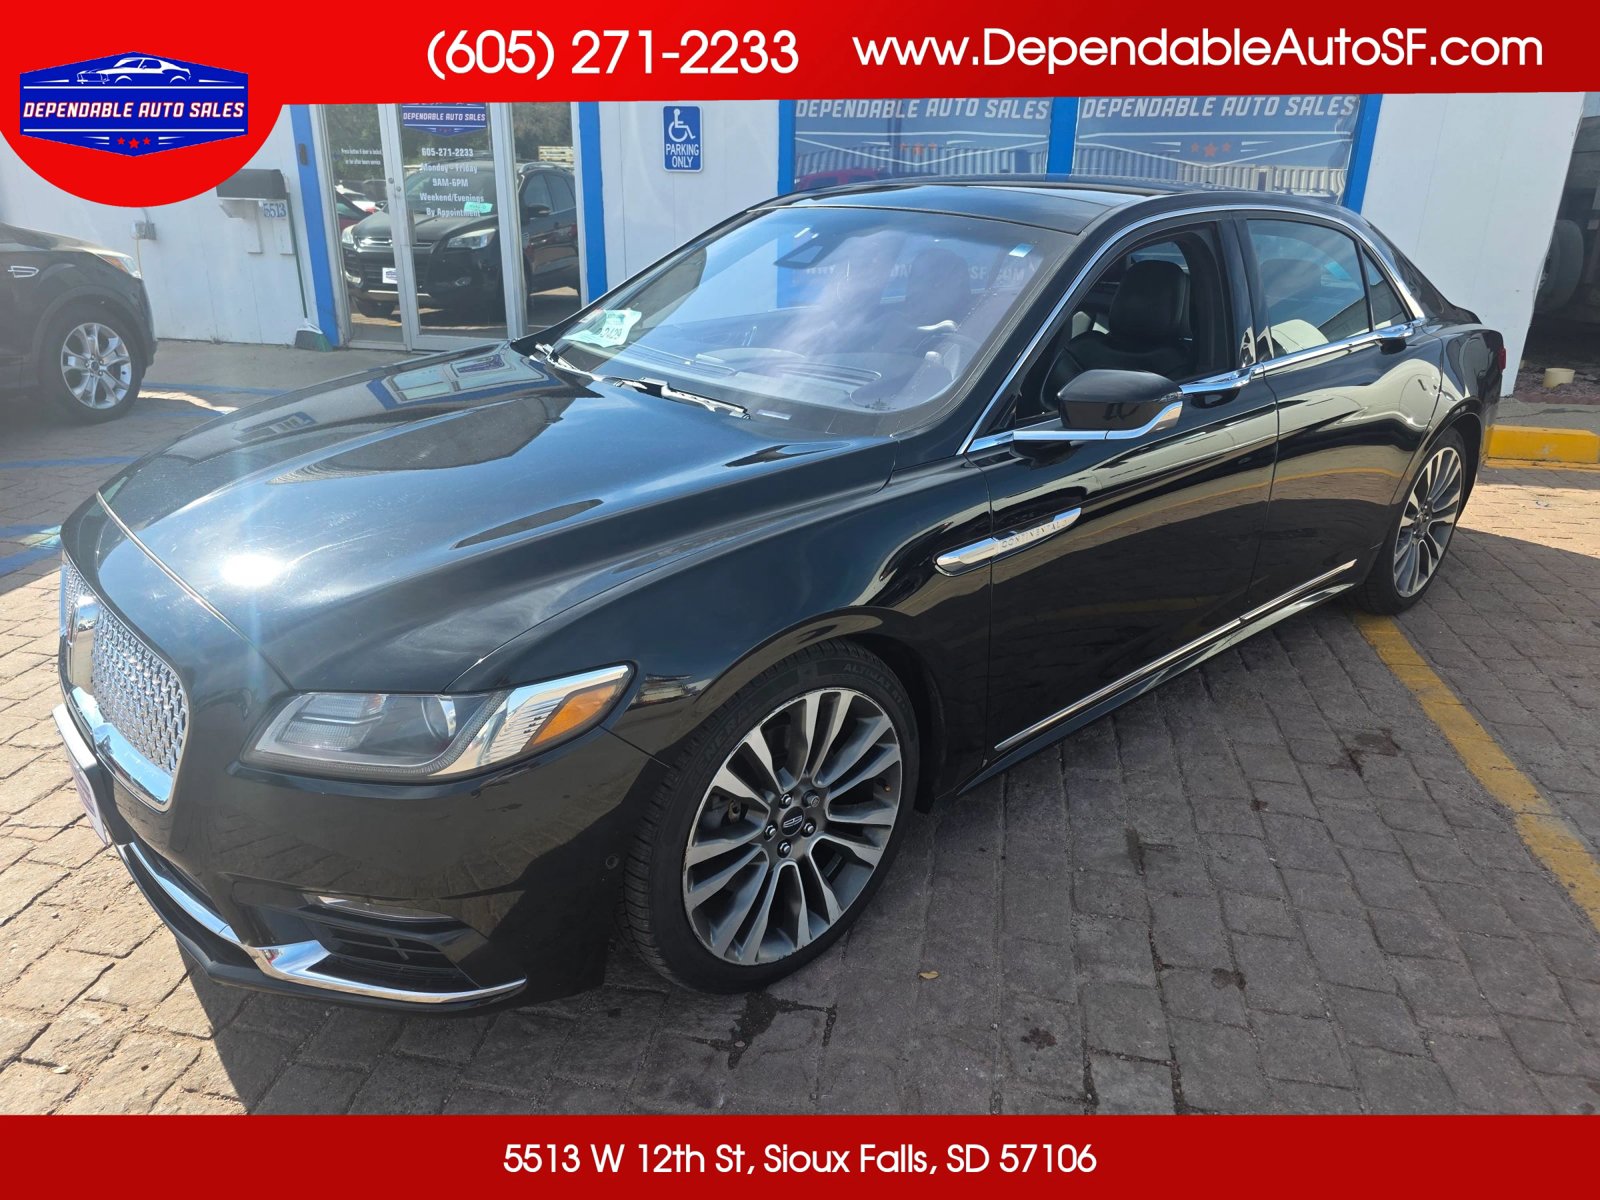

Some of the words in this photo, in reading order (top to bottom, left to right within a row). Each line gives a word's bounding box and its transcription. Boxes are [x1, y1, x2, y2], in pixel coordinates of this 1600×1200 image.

[795, 99, 920, 118] DEPENDABLE
[925, 98, 979, 117] AUTO
[984, 99, 1050, 120] SALES
[1081, 97, 1217, 119] DEPENDABLE
[1220, 97, 1279, 117] AUTO
[1284, 96, 1355, 117] SALES
[402, 112, 444, 121] DEPENDABLE
[445, 113, 463, 121] AUTO
[464, 113, 486, 122] SALES
[421, 147, 474, 157] 605-271-2233
[665, 143, 699, 156] PARKING
[671, 155, 694, 168] ONLY
[421, 163, 449, 173] Monday
[455, 164, 478, 174] Friday
[432, 178, 469, 187] 9AM-6PM
[420, 192, 484, 203] Weekend/Evenings
[263, 203, 287, 218] 5513
[426, 207, 435, 217] By
[437, 207, 481, 217] Appointment
